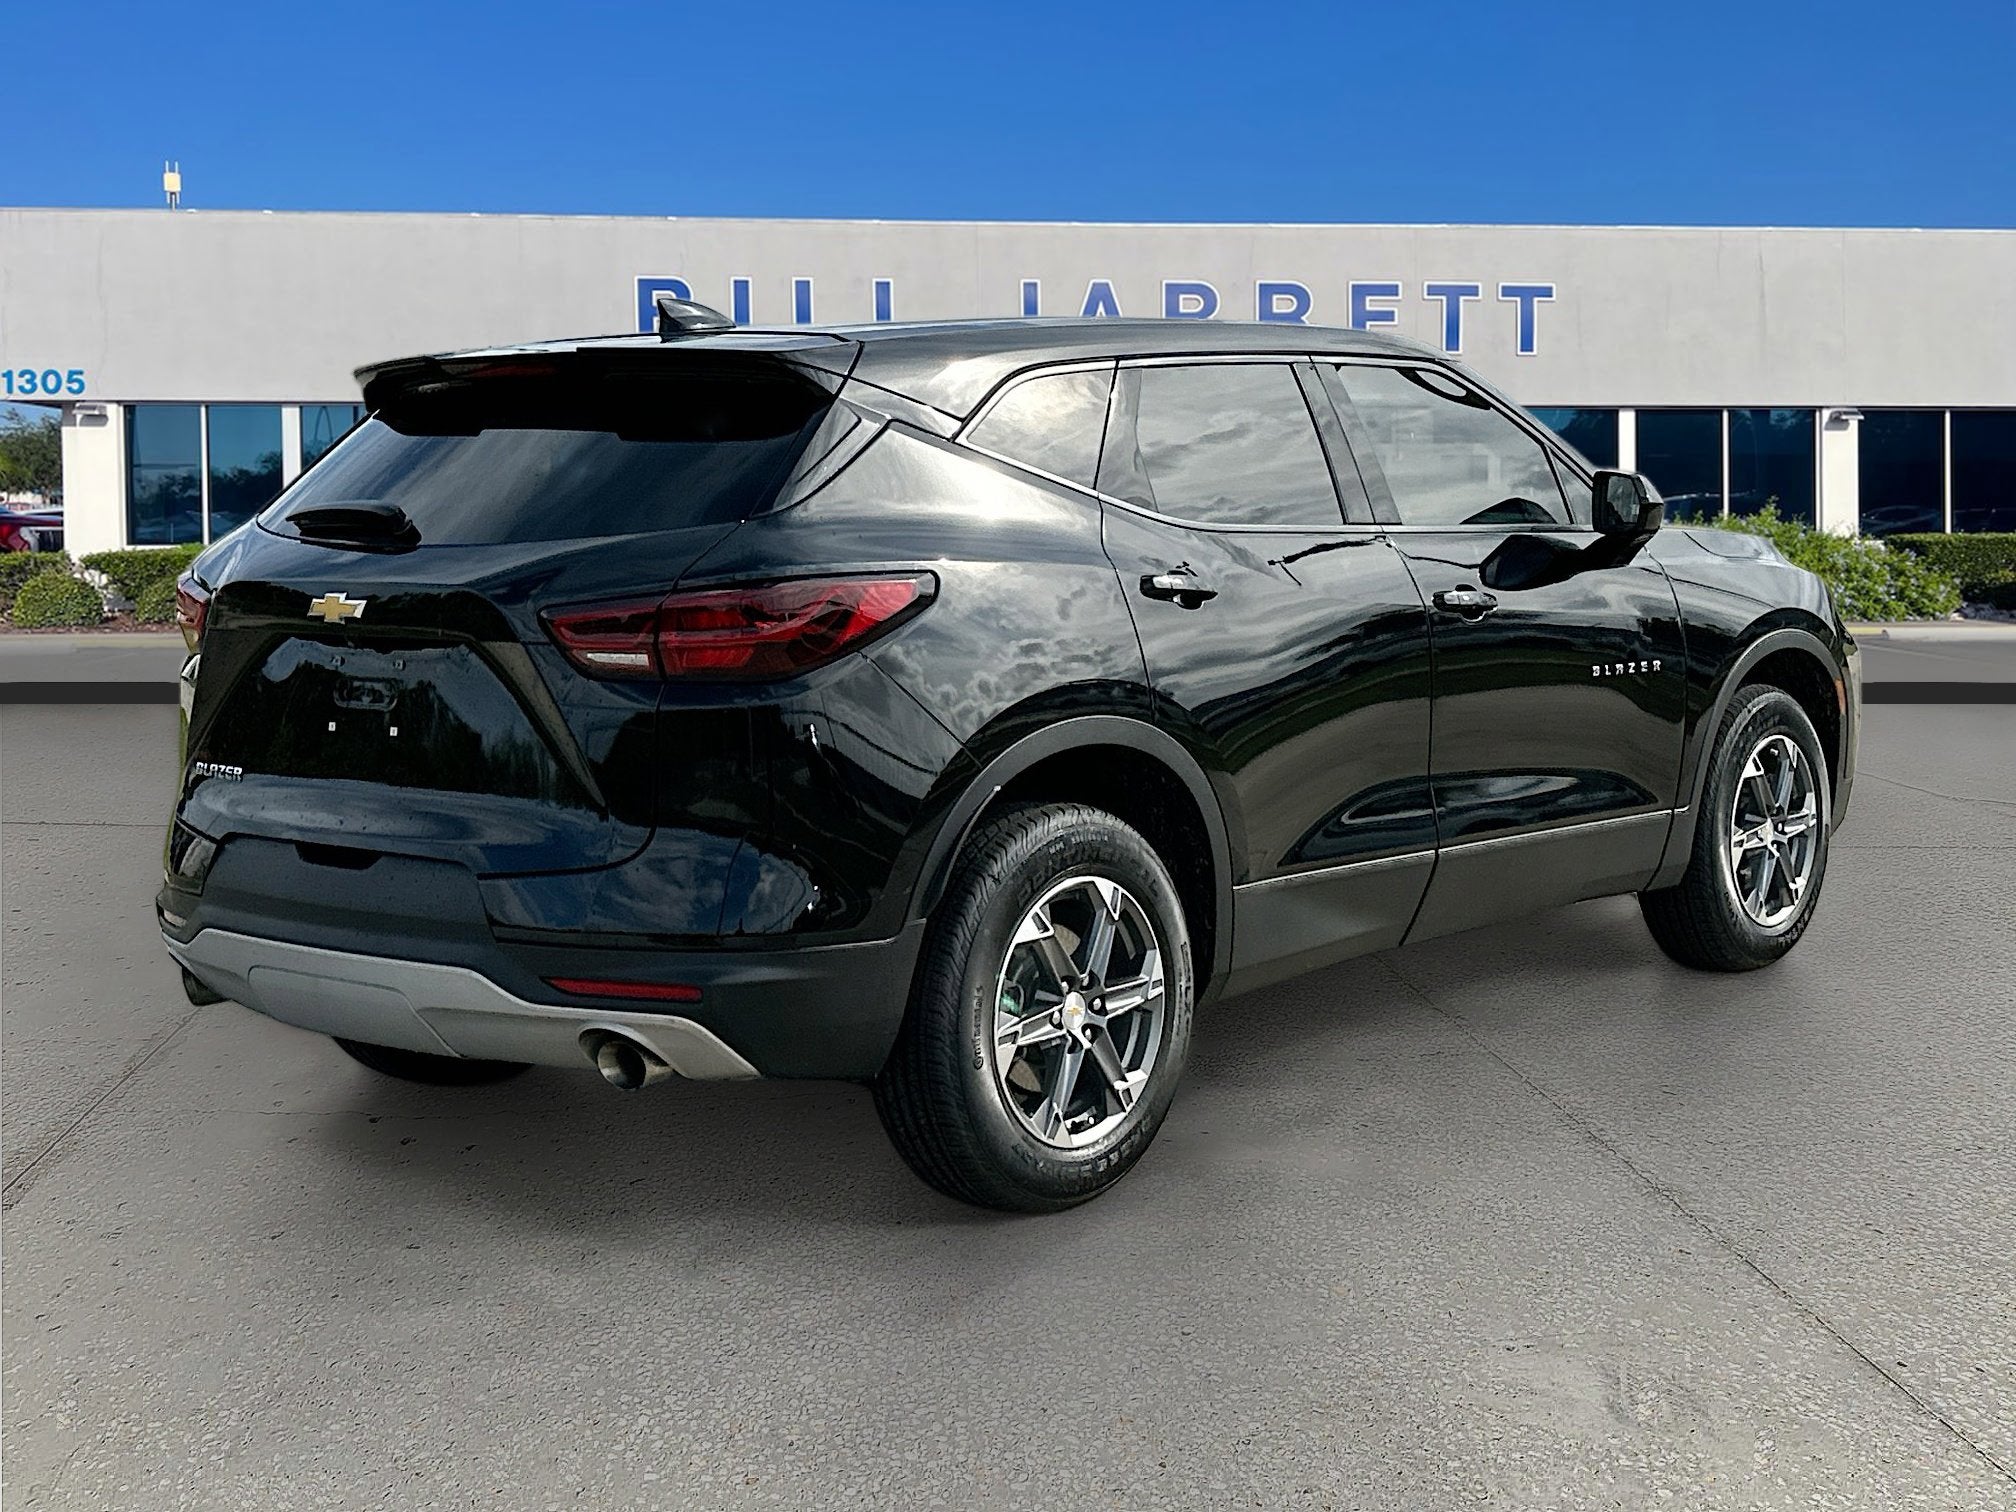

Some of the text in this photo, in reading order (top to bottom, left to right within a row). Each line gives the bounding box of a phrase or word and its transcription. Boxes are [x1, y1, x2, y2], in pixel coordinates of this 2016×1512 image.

[1, 368, 86, 395] 1305
[1592, 660, 1661, 676] BLAZER
[196, 761, 243, 780] BLAZER
